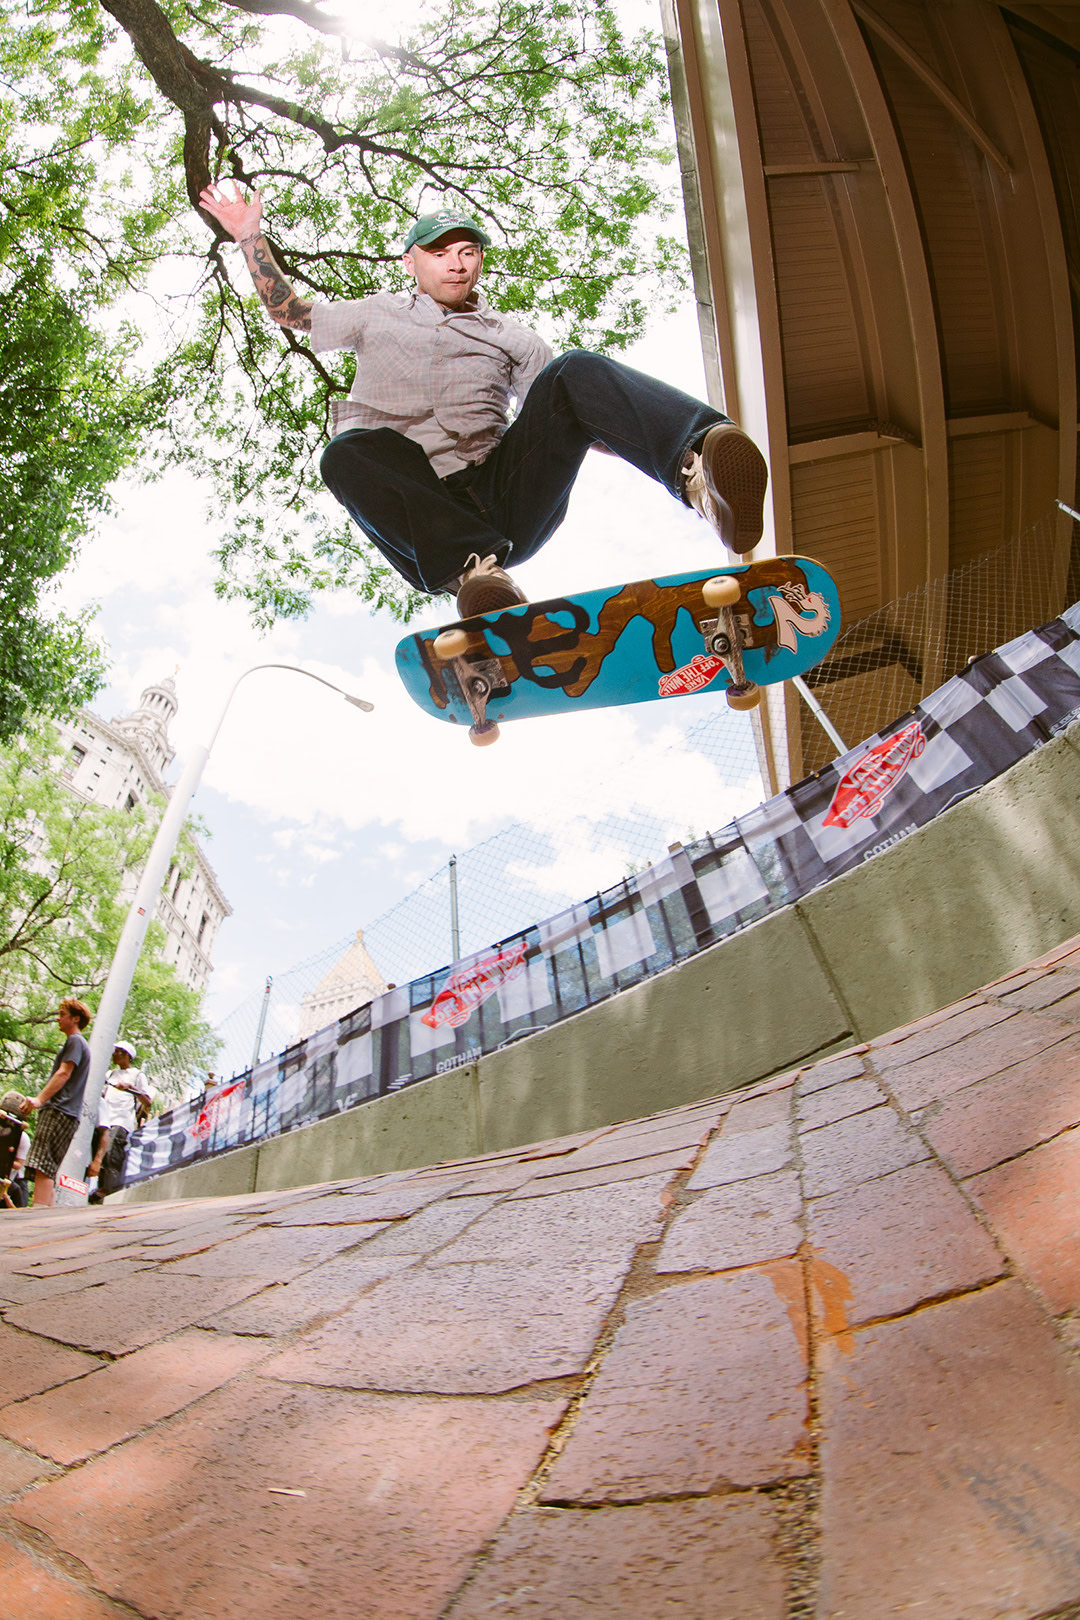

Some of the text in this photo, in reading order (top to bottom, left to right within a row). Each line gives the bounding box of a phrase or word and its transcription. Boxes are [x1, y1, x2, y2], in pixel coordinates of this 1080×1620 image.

[680, 667, 701, 683] THE
[685, 674, 710, 692] VANS
[860, 767, 899, 794] THE
[436, 1047, 482, 1074] GOTHAM
